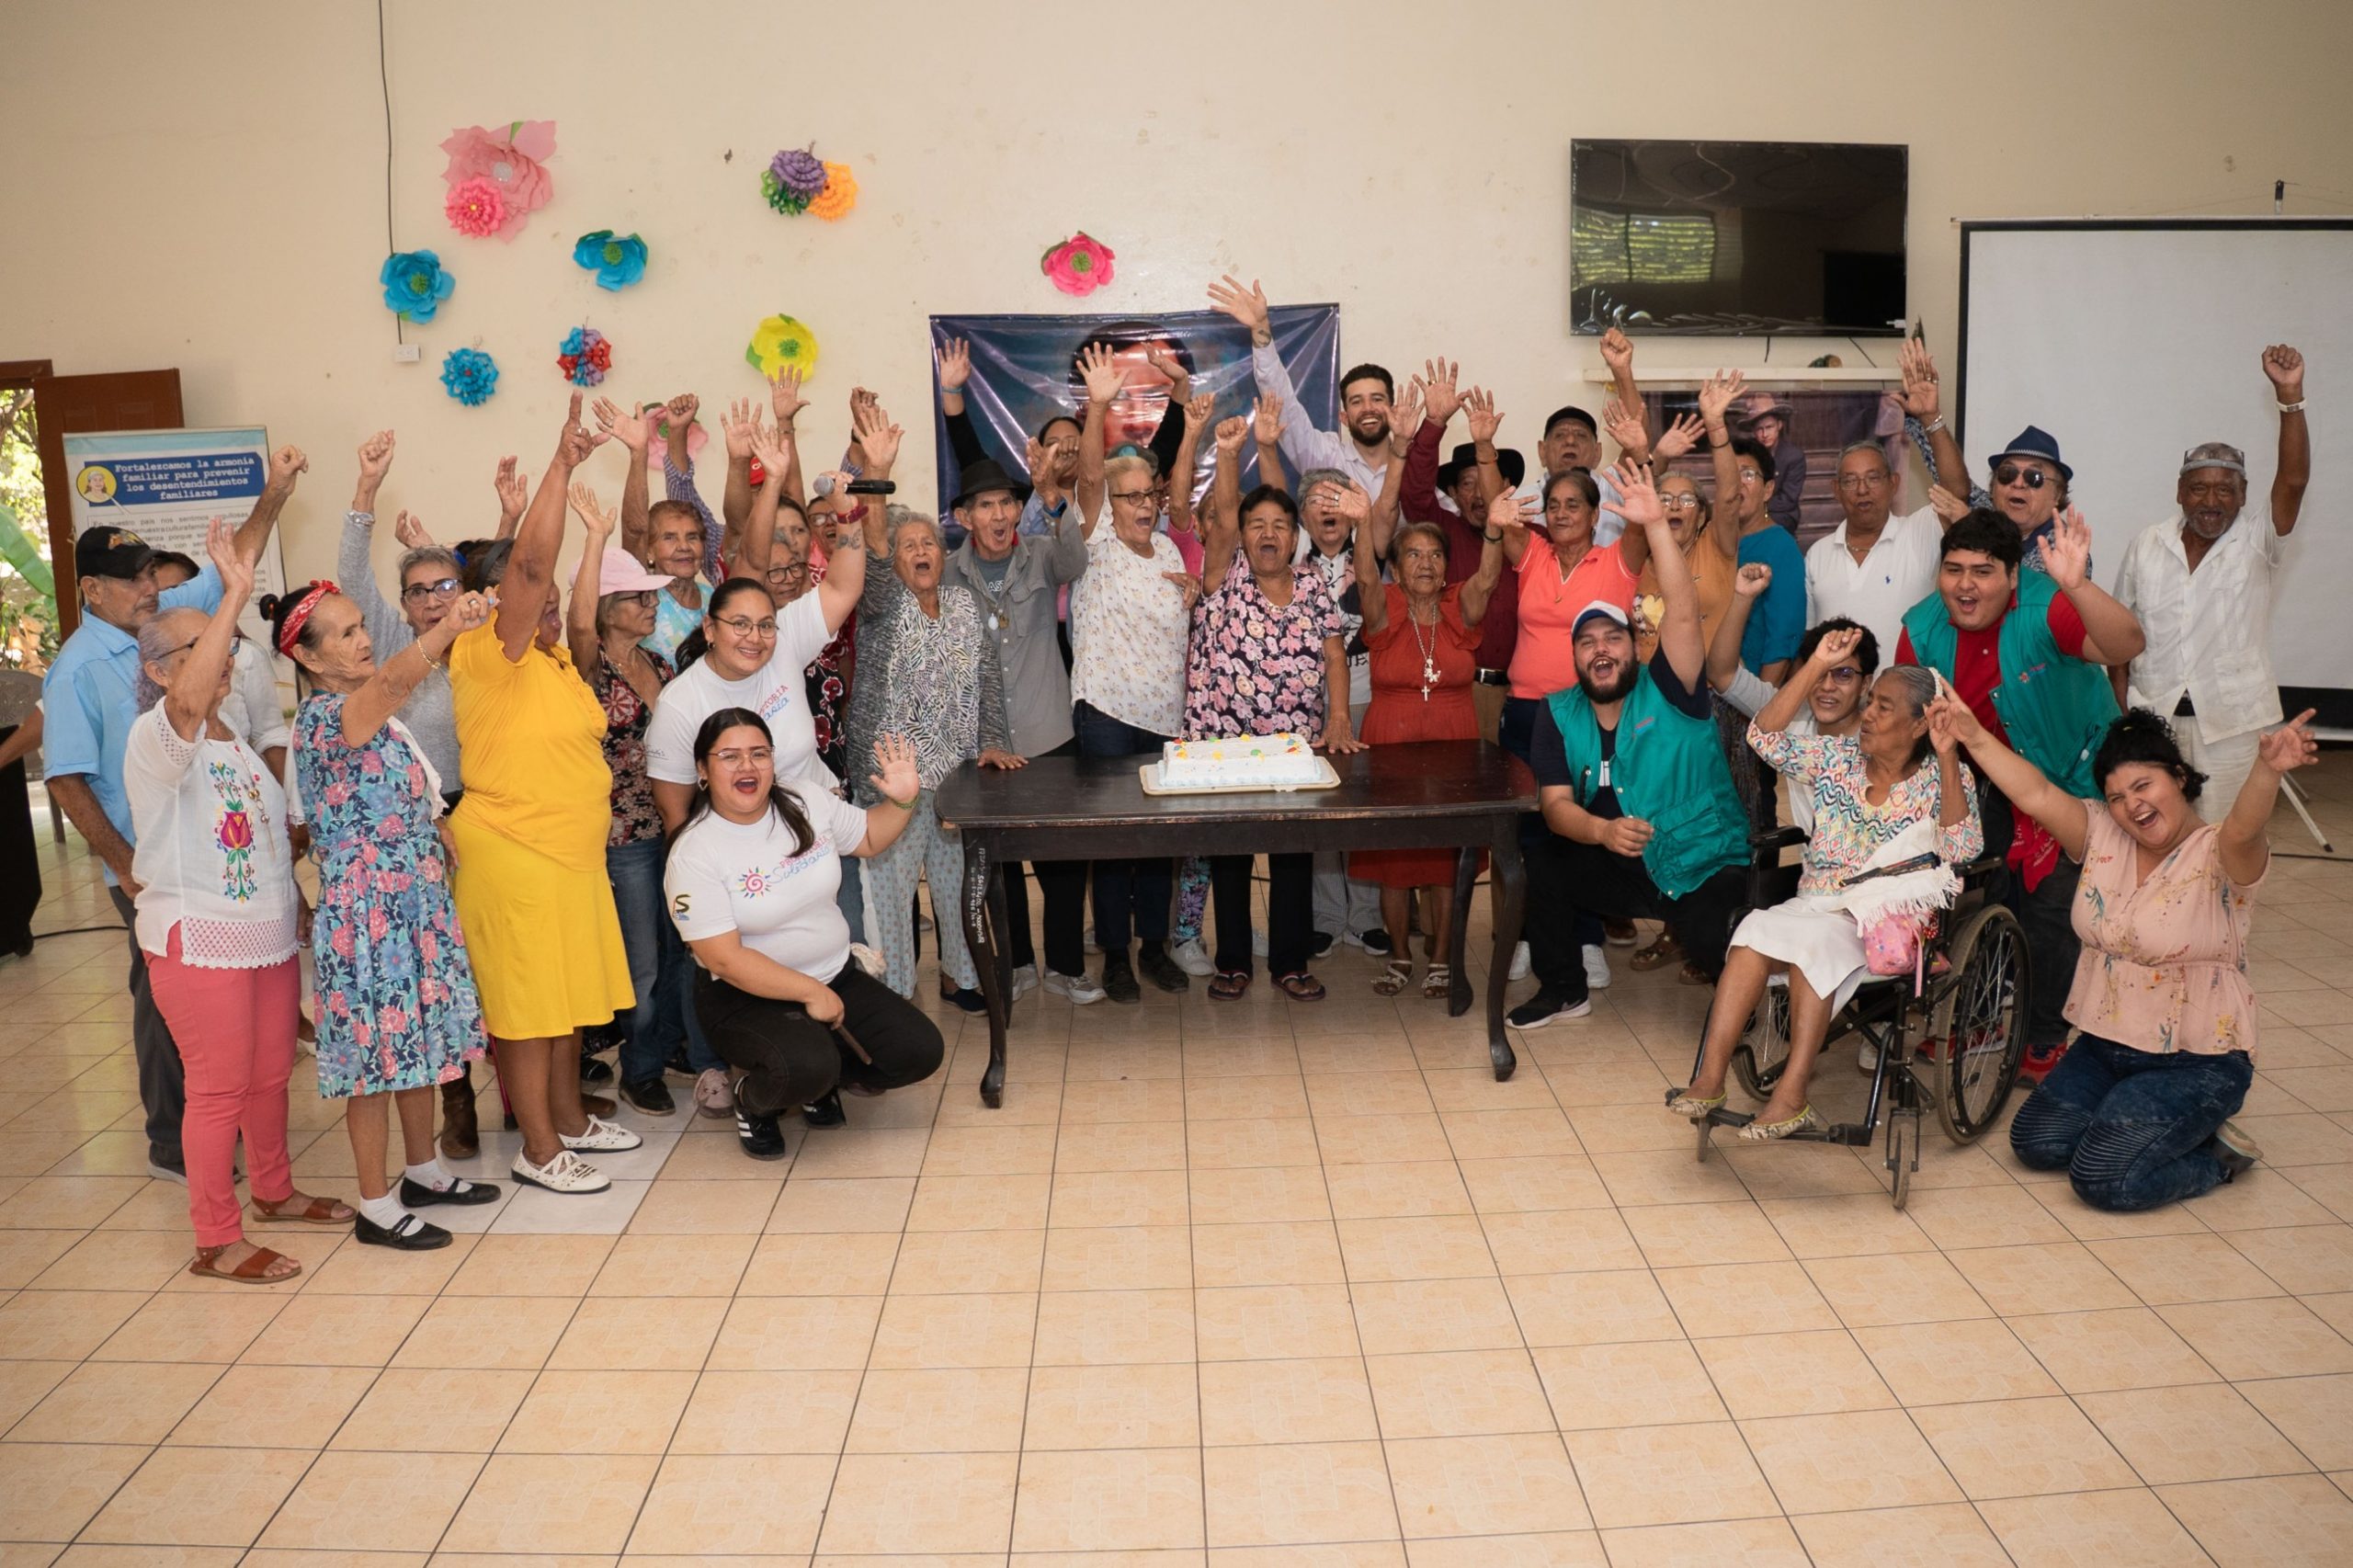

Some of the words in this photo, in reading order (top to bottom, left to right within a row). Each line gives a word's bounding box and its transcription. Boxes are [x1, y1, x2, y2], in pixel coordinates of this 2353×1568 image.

[115, 461, 192, 472] Fortalezcamos
[197, 460, 210, 468] la
[122, 472, 169, 483] familiar
[175, 472, 199, 481] para
[203, 467, 250, 479] prevenir
[127, 483, 144, 492] los
[150, 477, 248, 491] desentendimientos
[160, 489, 219, 500] familiares
